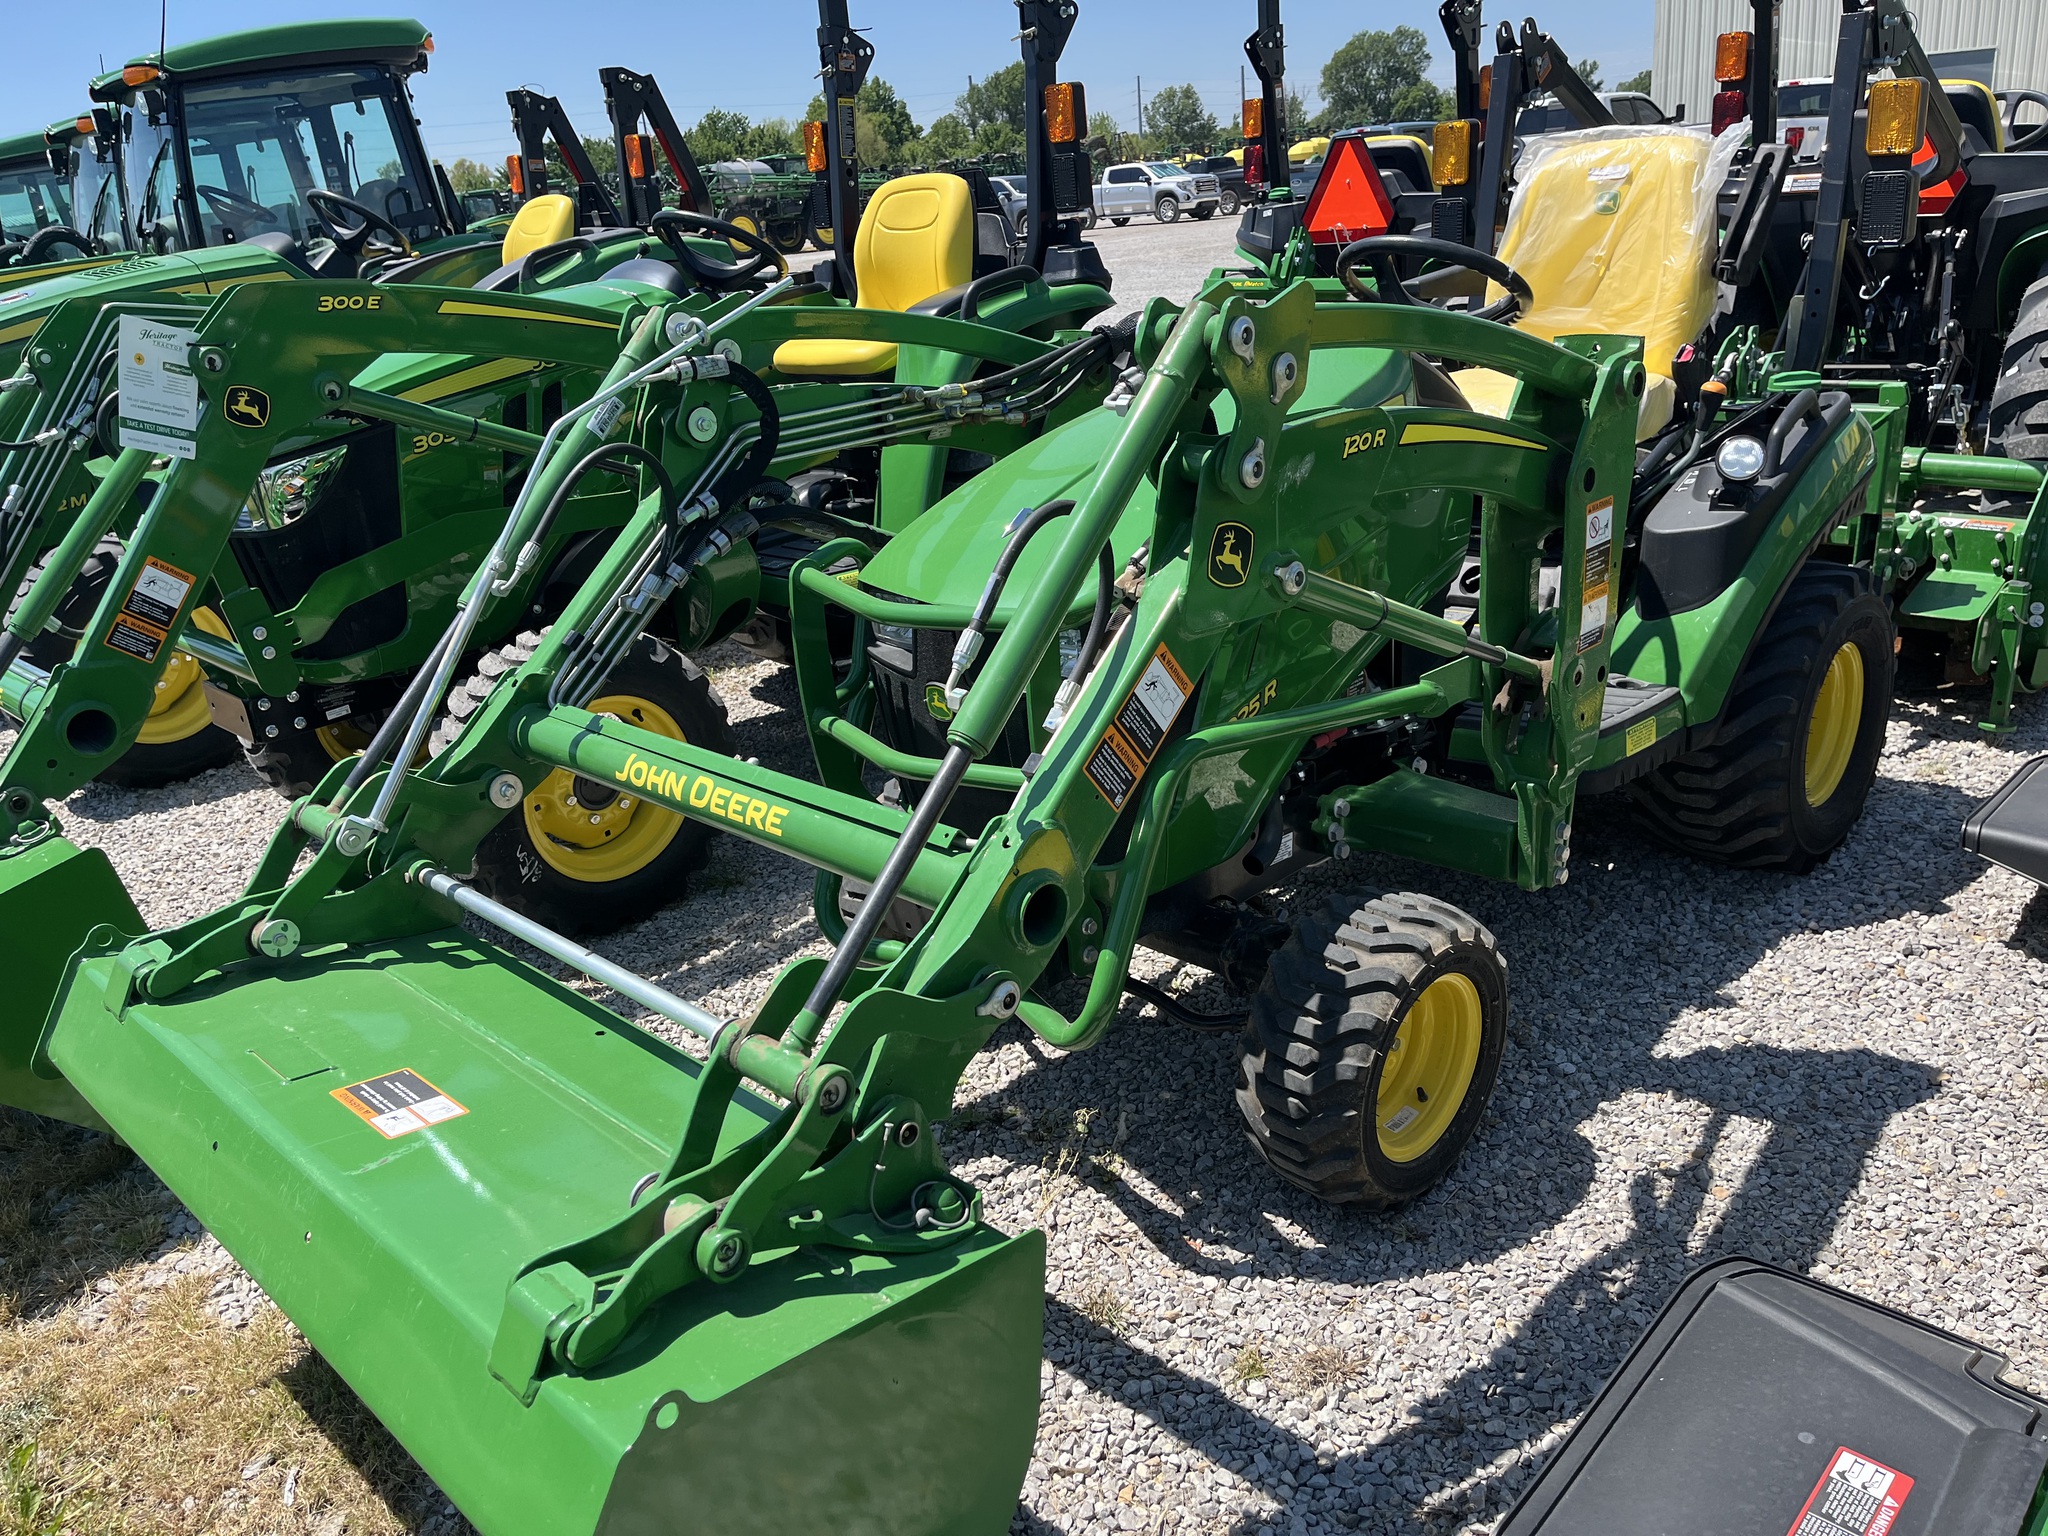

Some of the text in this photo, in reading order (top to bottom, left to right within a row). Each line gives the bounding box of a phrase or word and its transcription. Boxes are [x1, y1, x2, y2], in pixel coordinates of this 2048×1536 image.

[317, 295, 381, 312] 300 E
[139, 328, 178, 341] Heritage
[153, 340, 182, 352] TRACTOR
[126, 419, 139, 429] TAKE
[144, 423, 156, 431] TEST
[156, 425, 171, 435] DRIVE
[1342, 428, 1387, 459] 120 R
[159, 562, 190, 581] WARNING
[130, 620, 161, 638] WARNING
[1165, 657, 1189, 691] WARNING
[1115, 740, 1139, 773] WARNING
[615, 753, 790, 837] JOHN DEERE
